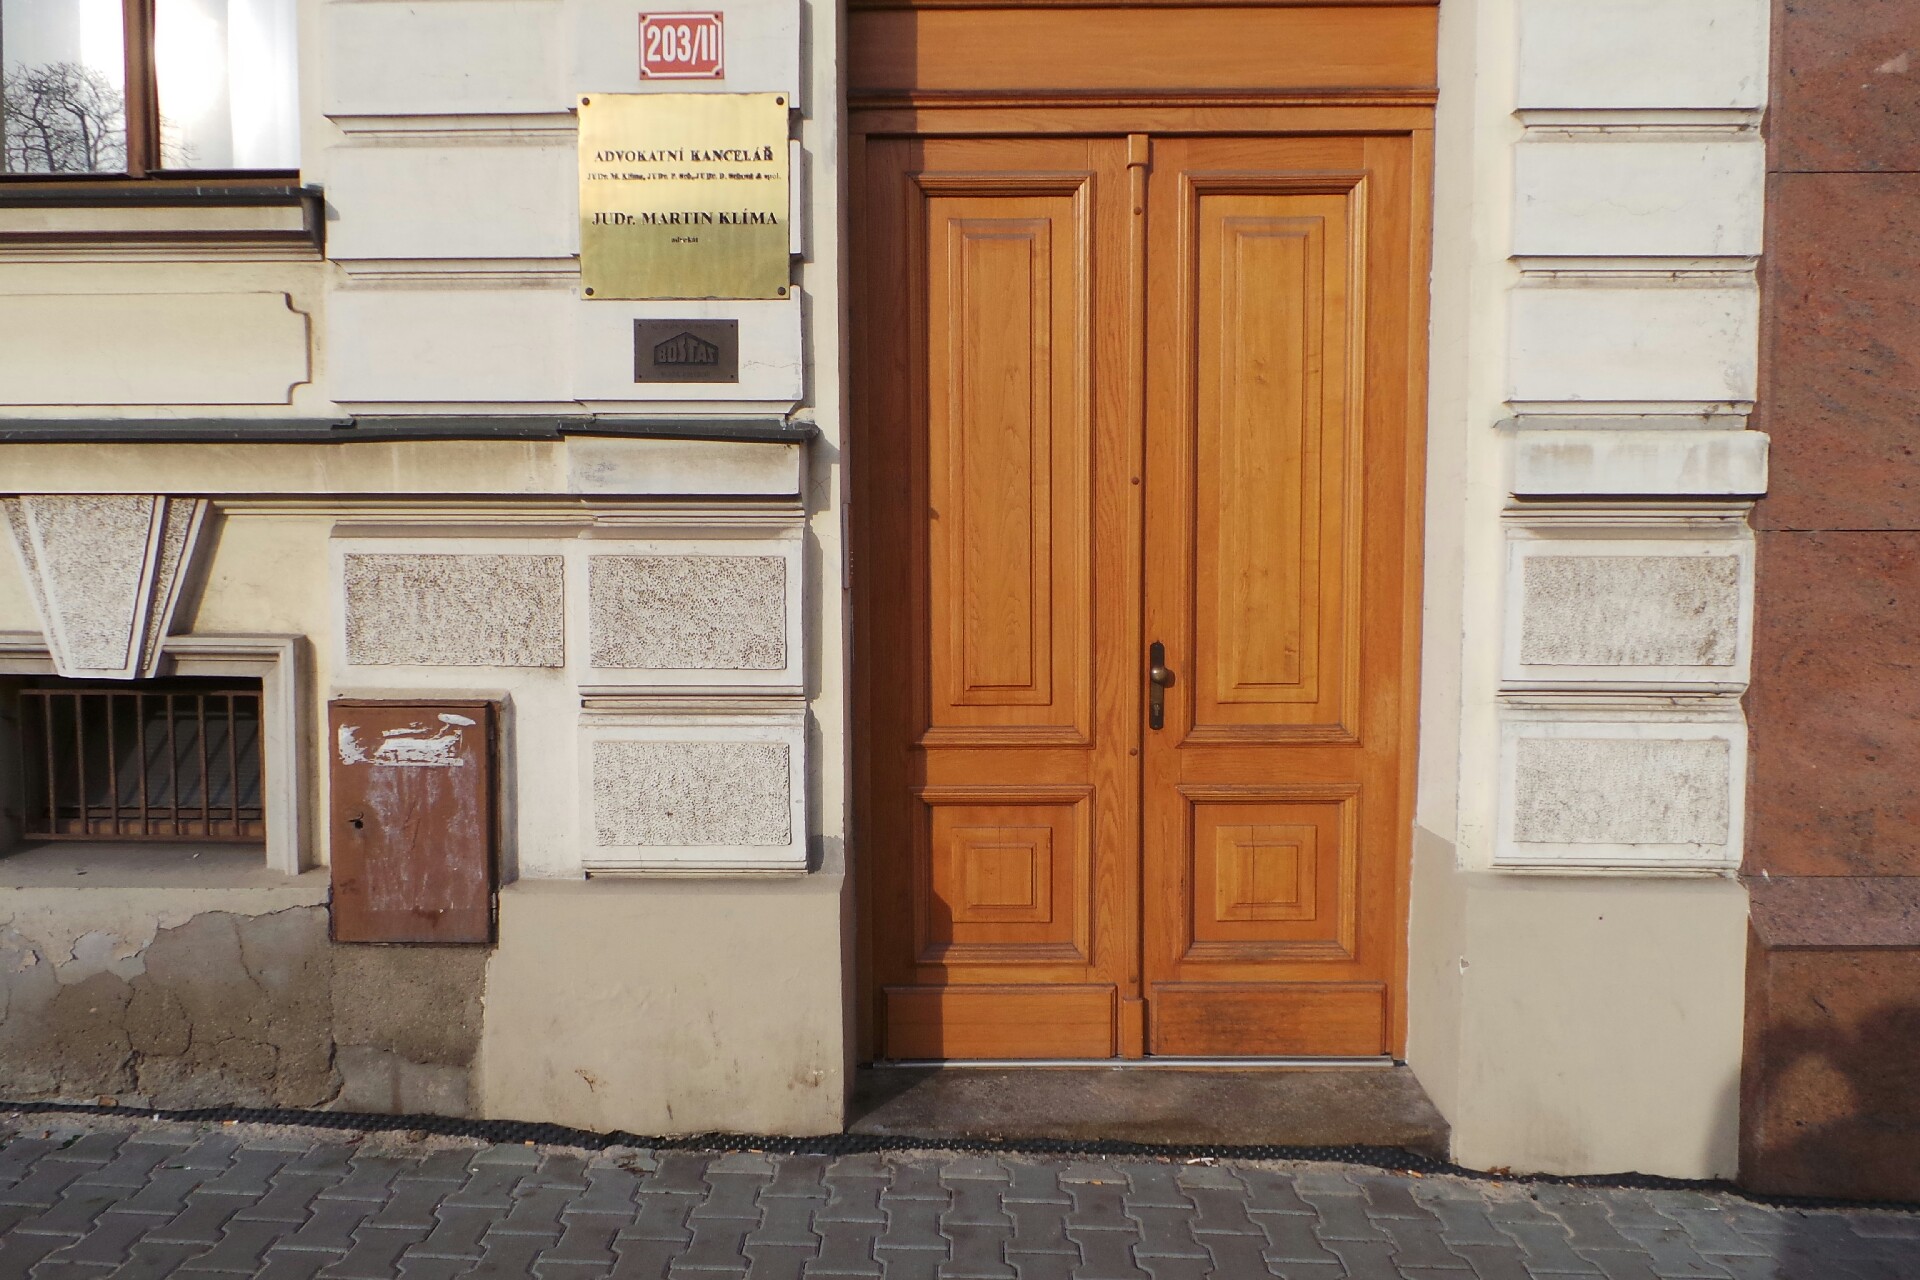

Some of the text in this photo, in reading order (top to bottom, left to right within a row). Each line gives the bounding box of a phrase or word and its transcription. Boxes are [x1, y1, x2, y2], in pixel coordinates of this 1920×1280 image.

[647, 24, 716, 65] 203/II
[691, 146, 773, 162] KANCELÁŘ
[592, 208, 778, 225] JUDr. MARTIN KLÍMA
